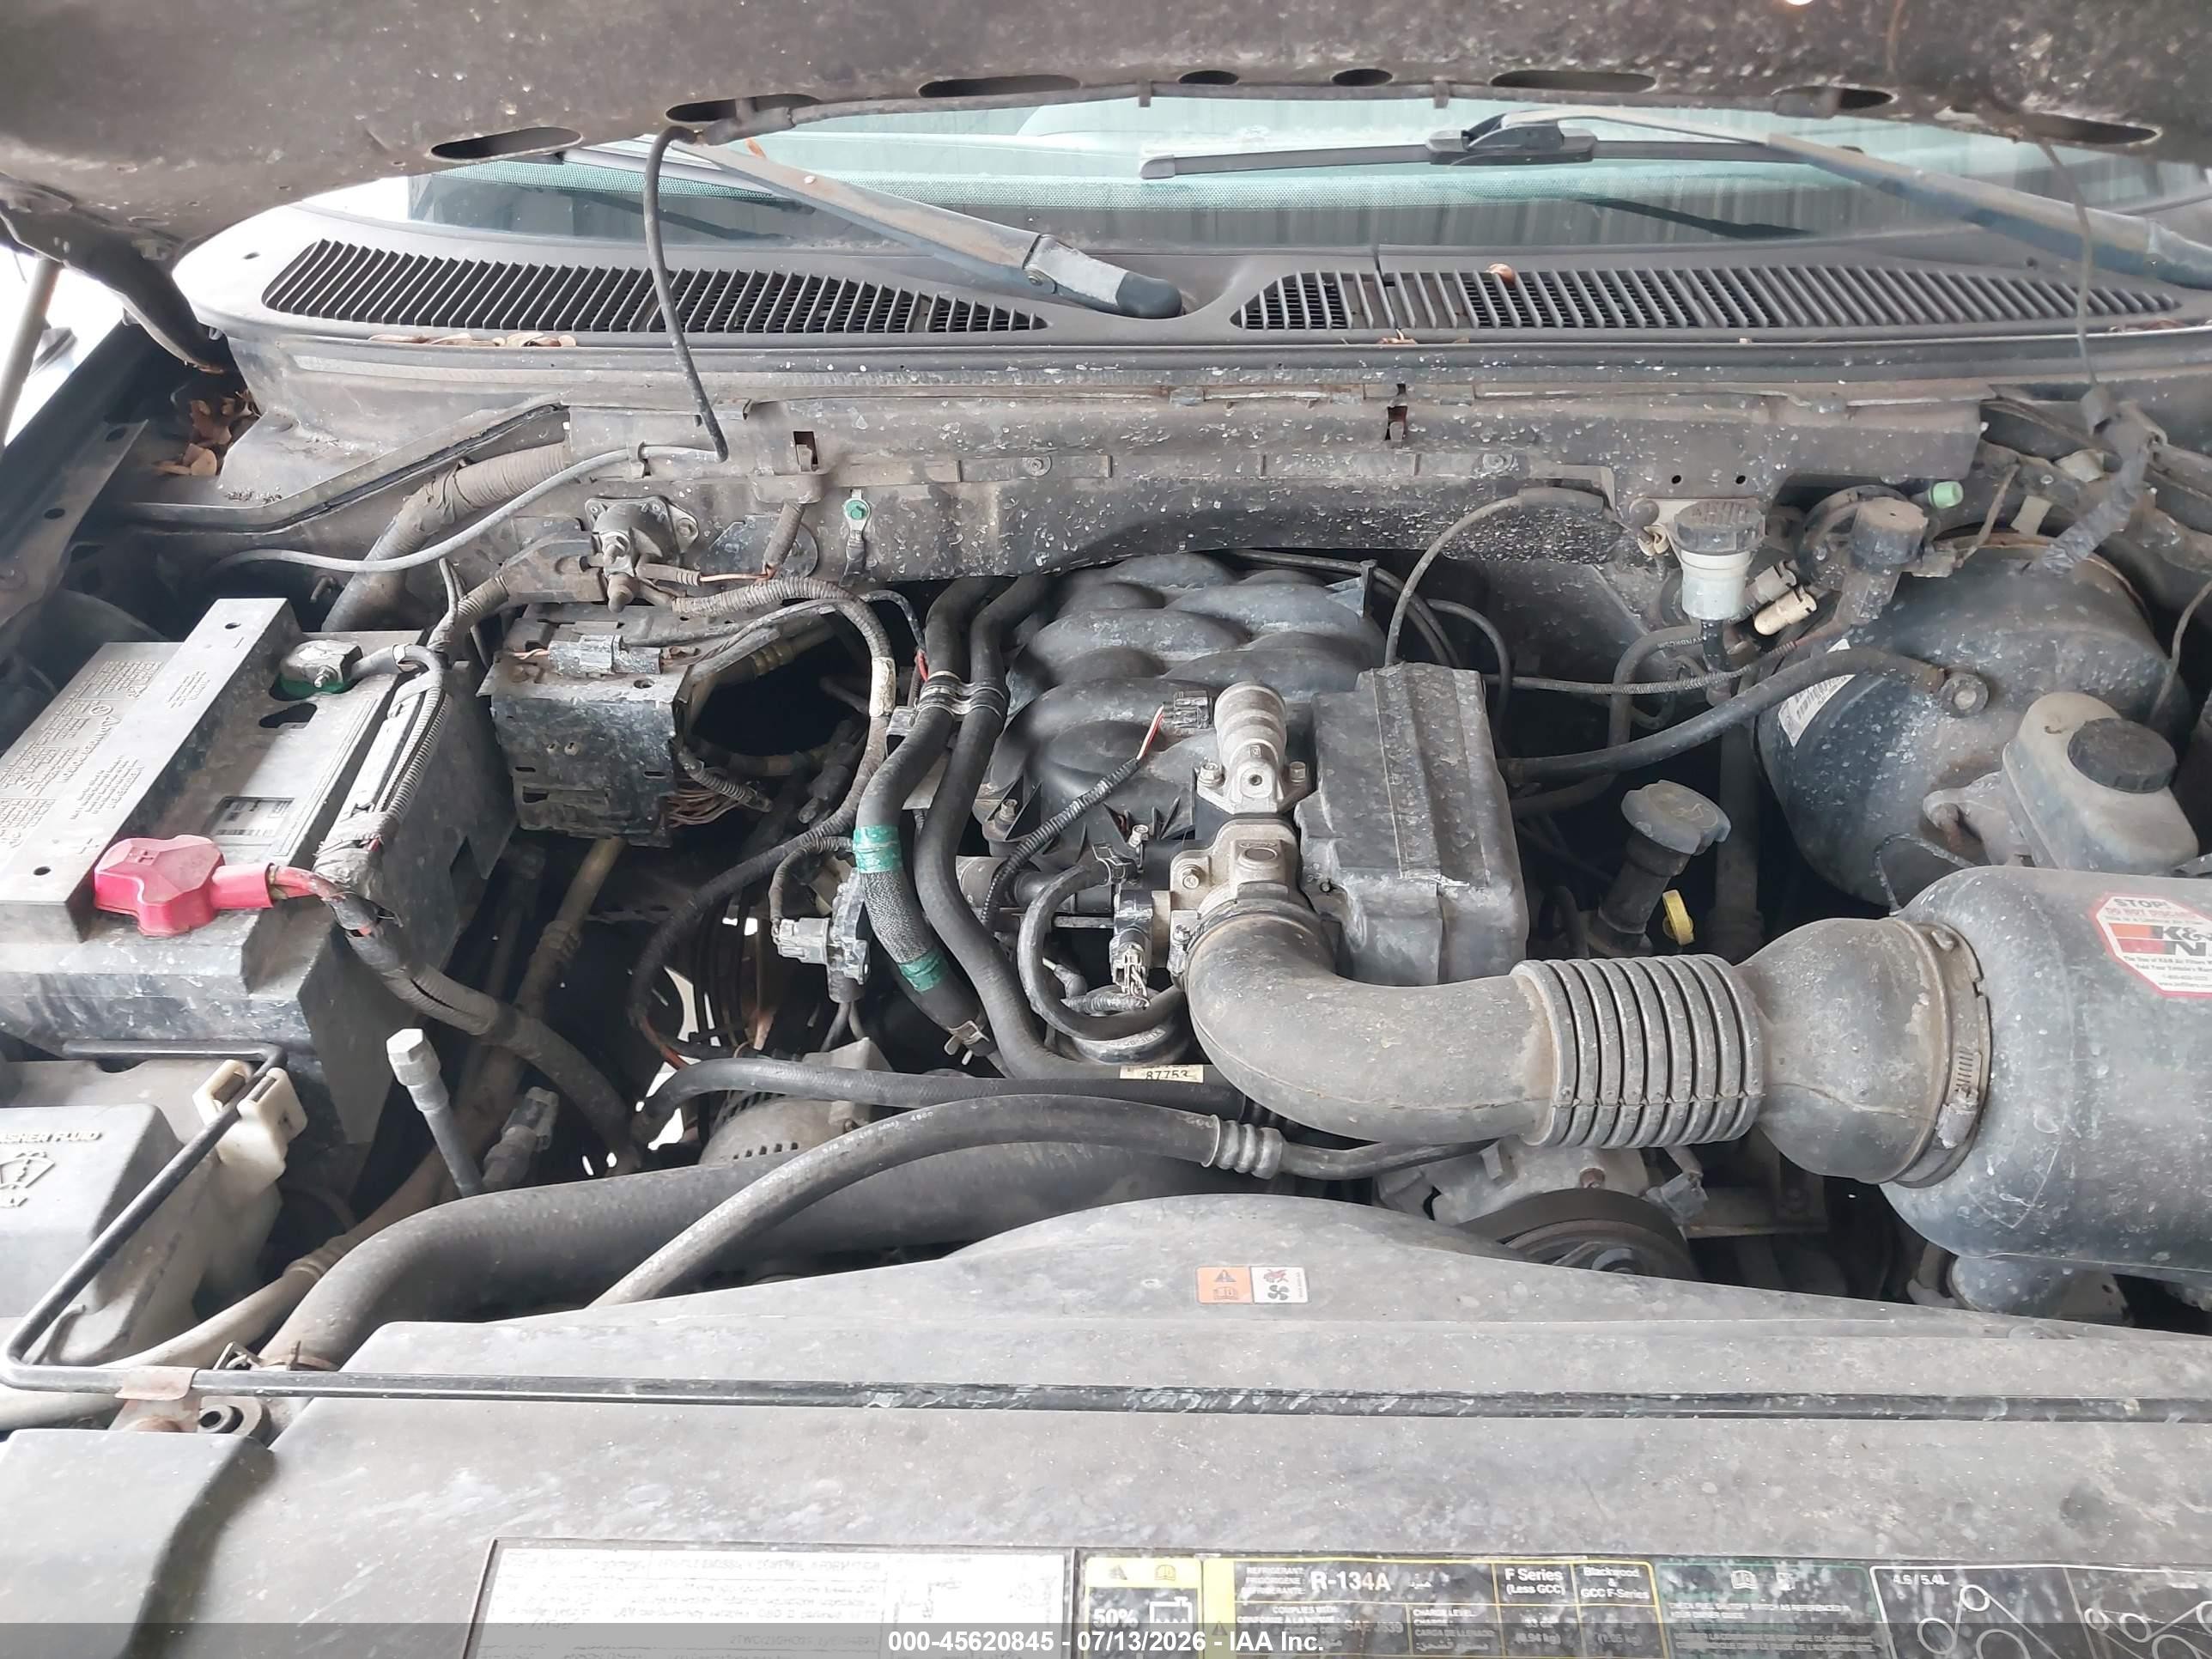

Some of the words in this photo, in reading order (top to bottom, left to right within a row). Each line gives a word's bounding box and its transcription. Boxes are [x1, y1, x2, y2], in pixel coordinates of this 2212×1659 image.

[1310, 1571, 1392, 1592] R-134A
[1504, 1568, 1516, 1581] F
[1518, 1568, 1564, 1582] Series
[1537, 1584, 1566, 1595] GCC)
[1580, 1588, 1606, 1599] GCC
[1092, 1607, 1139, 1629] 50%
